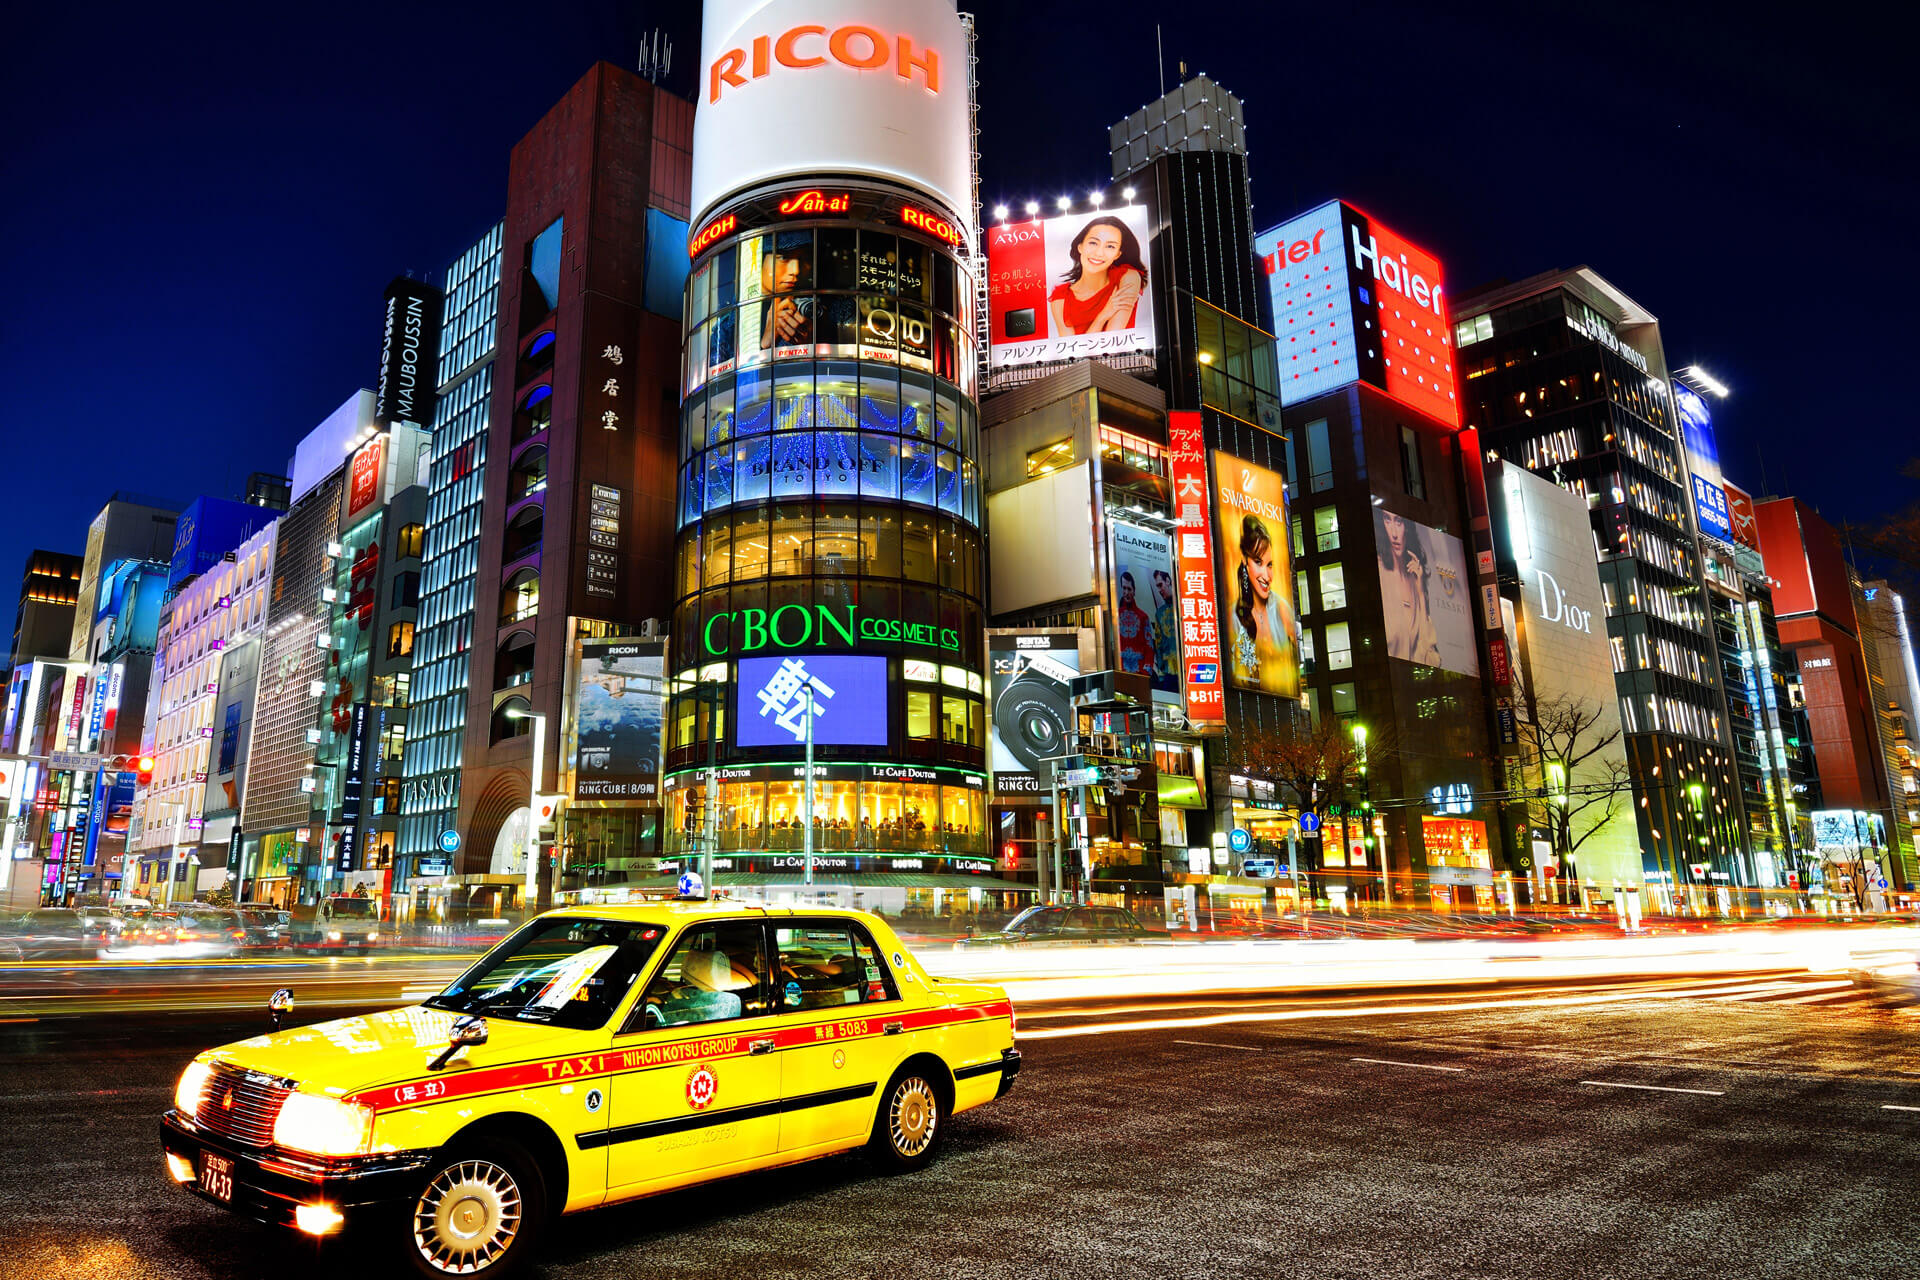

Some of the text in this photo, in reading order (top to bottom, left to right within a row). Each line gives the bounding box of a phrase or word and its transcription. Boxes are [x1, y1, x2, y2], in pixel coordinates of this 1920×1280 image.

[709, 25, 940, 105] RICOH
[781, 191, 849, 214] San-ai
[690, 215, 736, 257] RICOH
[903, 207, 961, 246] RICOH
[994, 230, 1040, 246] ARSOA
[1351, 224, 1442, 316] Haier
[1001, 333, 1146, 360] アルソア クイーンシルバー
[1585, 318, 1619, 352] GIORGIO
[397, 296, 423, 417] MAUBOUSSIN
[778, 348, 808, 357] PENTAX
[864, 350, 893, 360] PENTAX
[601, 345, 623, 431] 鳩居堂
[1170, 428, 1201, 441] ブランド
[1171, 450, 1203, 463] チケット
[784, 473, 847, 483] TOYO
[1177, 473, 1207, 558] 大黒屋
[1221, 487, 1283, 523] SWAROVSKI
[1116, 533, 1152, 550] LILANZ
[1184, 571, 1208, 596] 質
[1182, 598, 1214, 620] 買取
[1535, 569, 1592, 634] Dior
[704, 604, 858, 655] C'BON
[860, 617, 959, 650] COSMETCS
[1016, 637, 1050, 645] PENTAX
[1184, 621, 1216, 643] 販売
[111, 673, 121, 698] docomo
[1199, 691, 1221, 703] B1F
[756, 658, 835, 742] 転
[722, 769, 751, 778] DOUTOR
[873, 767, 936, 779] LE CAFÉ DOUTOR
[402, 775, 455, 802] TASAKI
[579, 785, 601, 794] RING
[603, 784, 626, 794] CUBE
[998, 782, 1023, 791] RING
[94, 800, 103, 824] citibank
[773, 857, 784, 866] LE
[786, 857, 806, 866] CAF
[814, 1021, 868, 1039] 無線 5083
[623, 1038, 738, 1067] NIHON KOTSU GROUP
[542, 1056, 605, 1079] TAXI
[206, 1168, 232, 1201] 74-33
